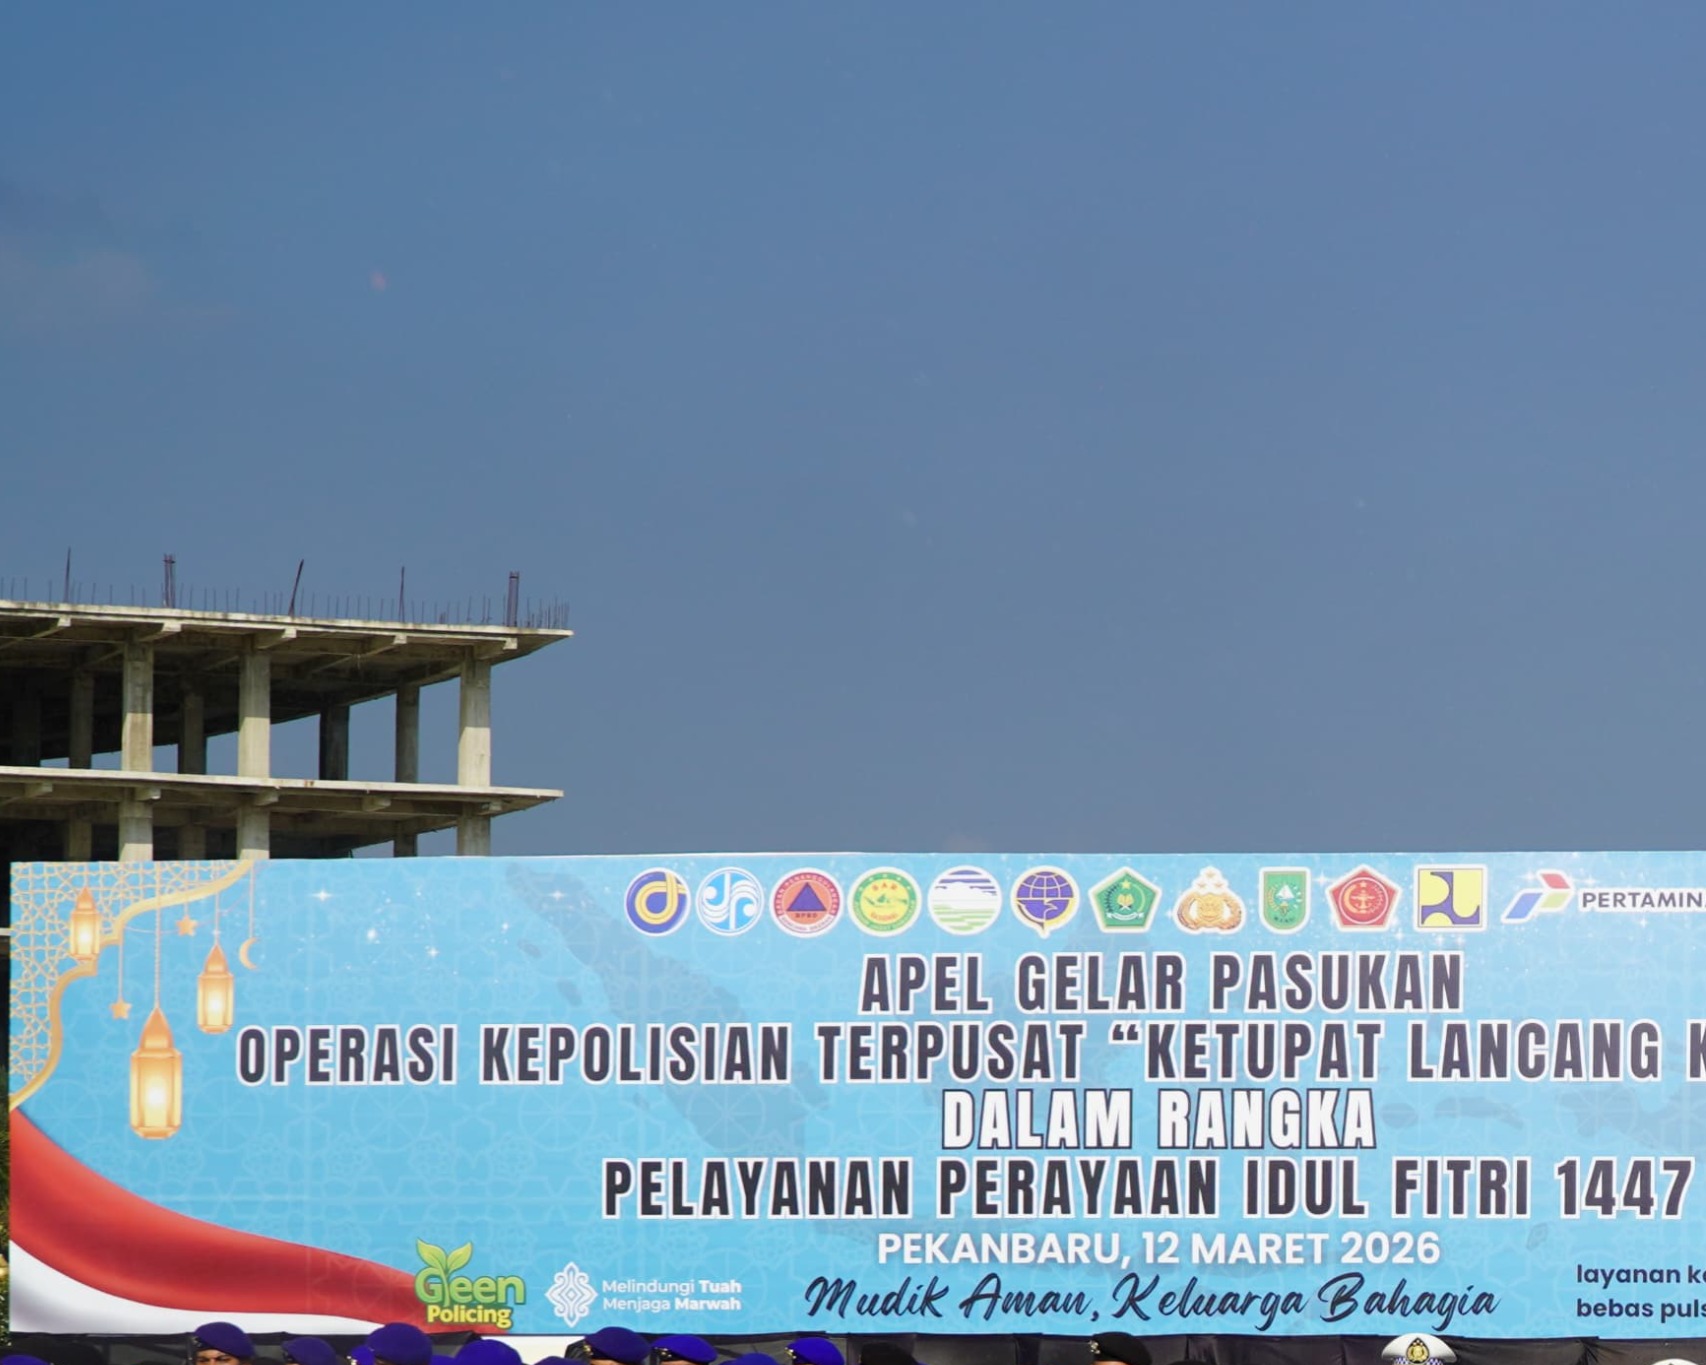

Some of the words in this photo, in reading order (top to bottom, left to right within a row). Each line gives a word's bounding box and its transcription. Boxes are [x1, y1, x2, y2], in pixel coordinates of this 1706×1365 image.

[859, 954, 991, 1013] APEL
[1016, 953, 1184, 1012] GELAR
[1211, 952, 1462, 1012] PASUKAN
[238, 1026, 456, 1085] OPERASI
[480, 1025, 792, 1084] KEPOLISIAN
[815, 1022, 1085, 1081] TERPUSAT
[1110, 1021, 1384, 1081] “KETUPAT
[1409, 1020, 1660, 1081] LANCANG
[941, 1088, 1134, 1150] DALAM
[1157, 1087, 1377, 1150] RANGKA
[603, 1158, 911, 1217] PELAYANAN
[938, 1158, 1218, 1217] PERAYAAN
[1245, 1158, 1367, 1217] IDUL
[1394, 1158, 1529, 1217] FITRI
[1555, 1158, 1693, 1217] 1447
[877, 1232, 1130, 1270] PEKANBARU,
[1142, 1231, 1180, 1265] 12
[1192, 1231, 1330, 1265] MARET
[1340, 1231, 1441, 1265] 2026
[602, 1278, 695, 1295] Melindungi
[698, 1279, 742, 1293] Tuah
[1576, 1264, 1681, 1290] layanan
[427, 1305, 513, 1329] Policing
[602, 1297, 671, 1313] Menjaga
[674, 1297, 742, 1311] Marwah
[804, 1275, 950, 1319] Mudik
[958, 1271, 1100, 1322] Aman,
[1111, 1271, 1309, 1332] Keluarga
[1317, 1271, 1501, 1332] Bahagia
[1576, 1298, 1654, 1318] bebas
